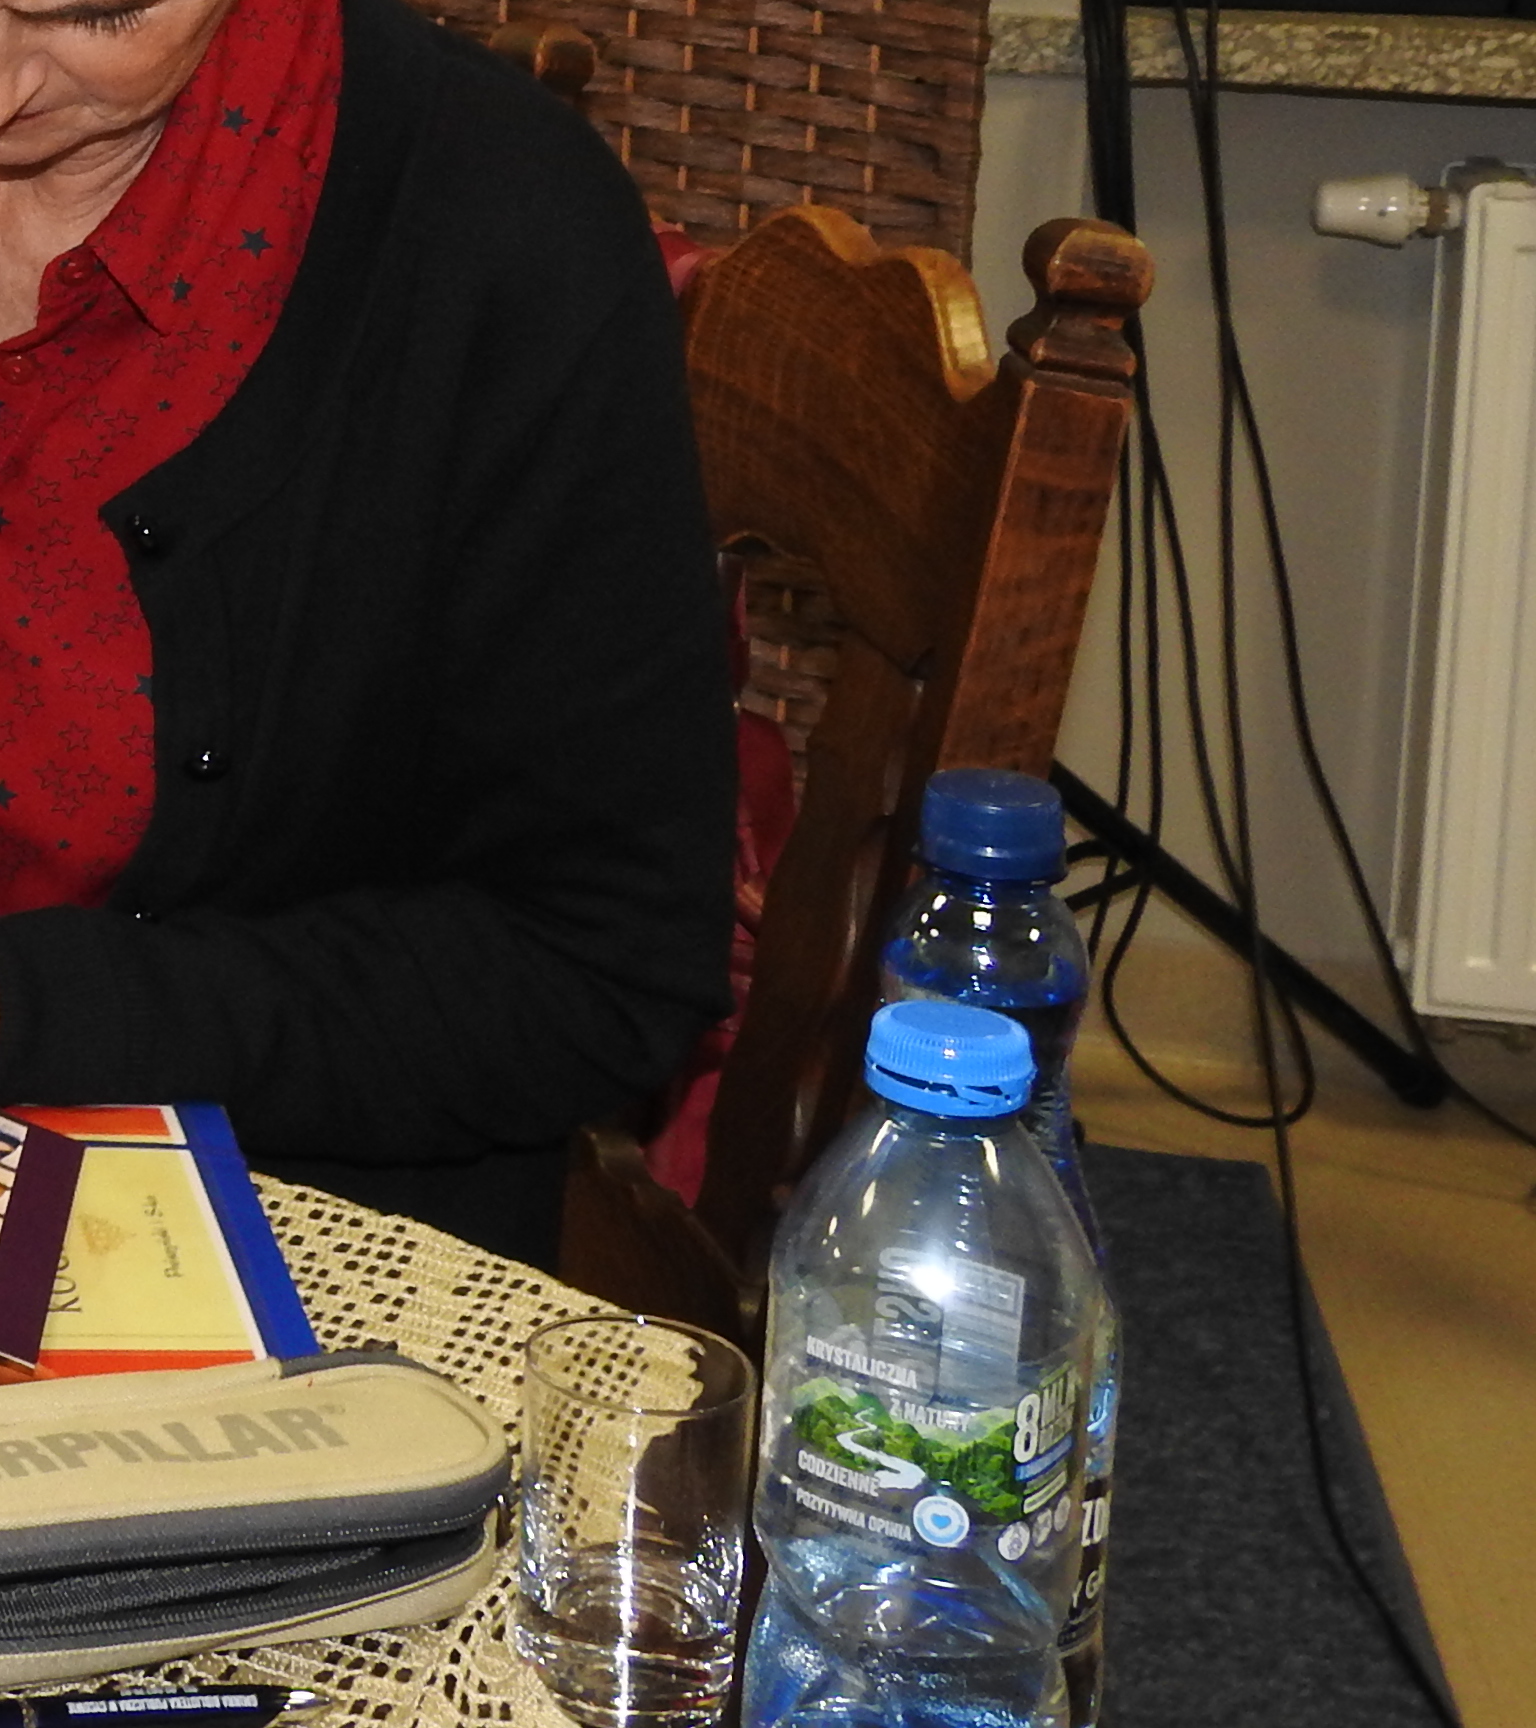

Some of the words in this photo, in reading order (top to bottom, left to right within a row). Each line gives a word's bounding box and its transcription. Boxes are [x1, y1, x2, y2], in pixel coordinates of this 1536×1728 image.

[806, 1334, 918, 1390] KRYSTALICZNA
[1013, 1393, 1040, 1463] 8
[868, 1515, 912, 1542] OPINIA
